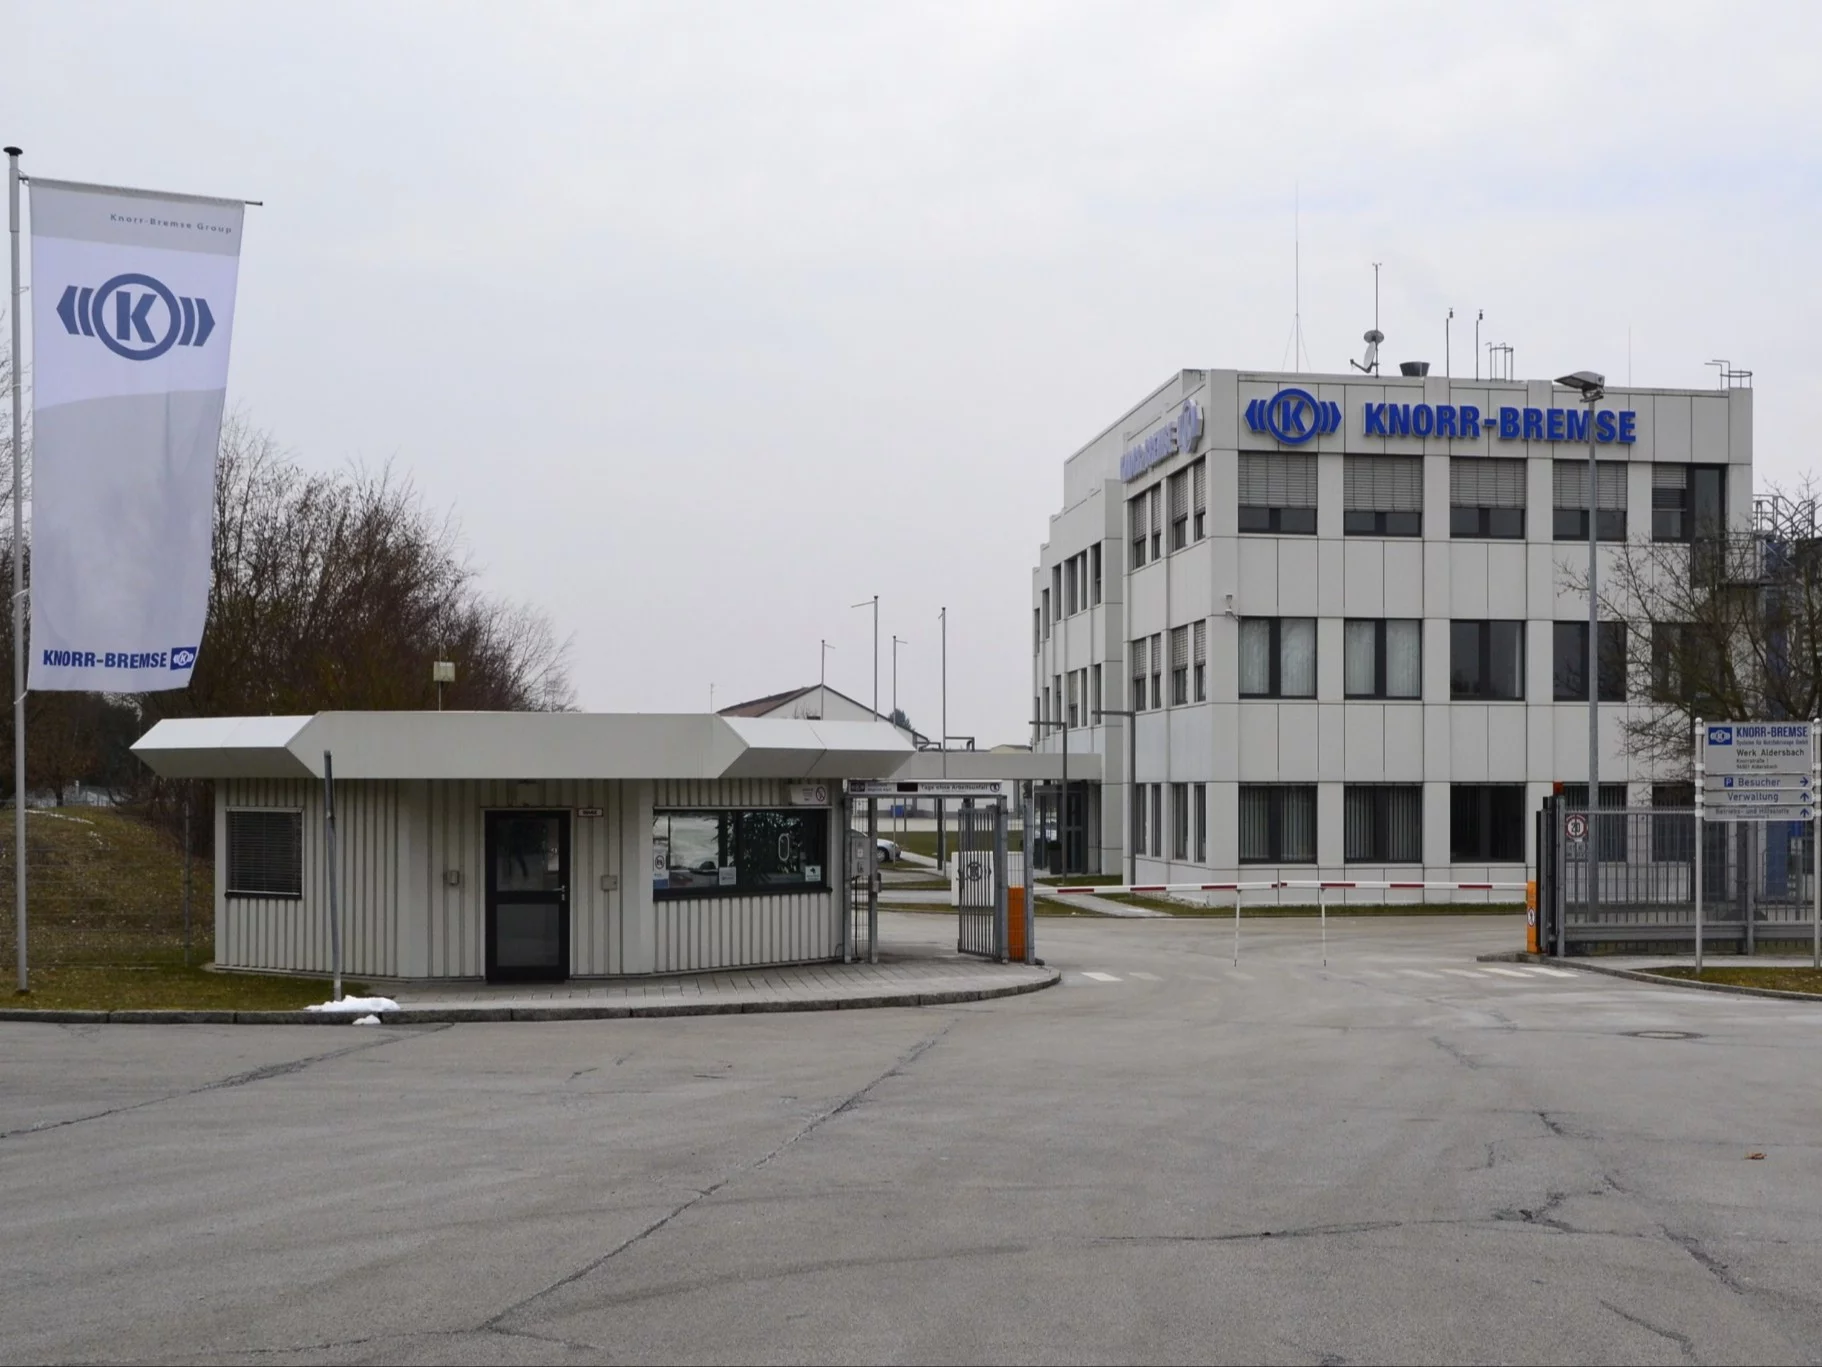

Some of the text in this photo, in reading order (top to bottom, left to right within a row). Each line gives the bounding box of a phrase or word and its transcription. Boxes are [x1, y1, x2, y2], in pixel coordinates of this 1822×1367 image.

[110, 213, 232, 234] Knorr-Bremse Group
[1364, 402, 1637, 443] KNORR-BREMSE
[43, 650, 167, 669] KNORR-BREMSE
[1736, 726, 1808, 738] KNORR-BREMSE
[1736, 748, 1805, 757] Werk Aldersbach
[1738, 777, 1781, 787] Besucher
[1727, 792, 1779, 803] Verwaltung
